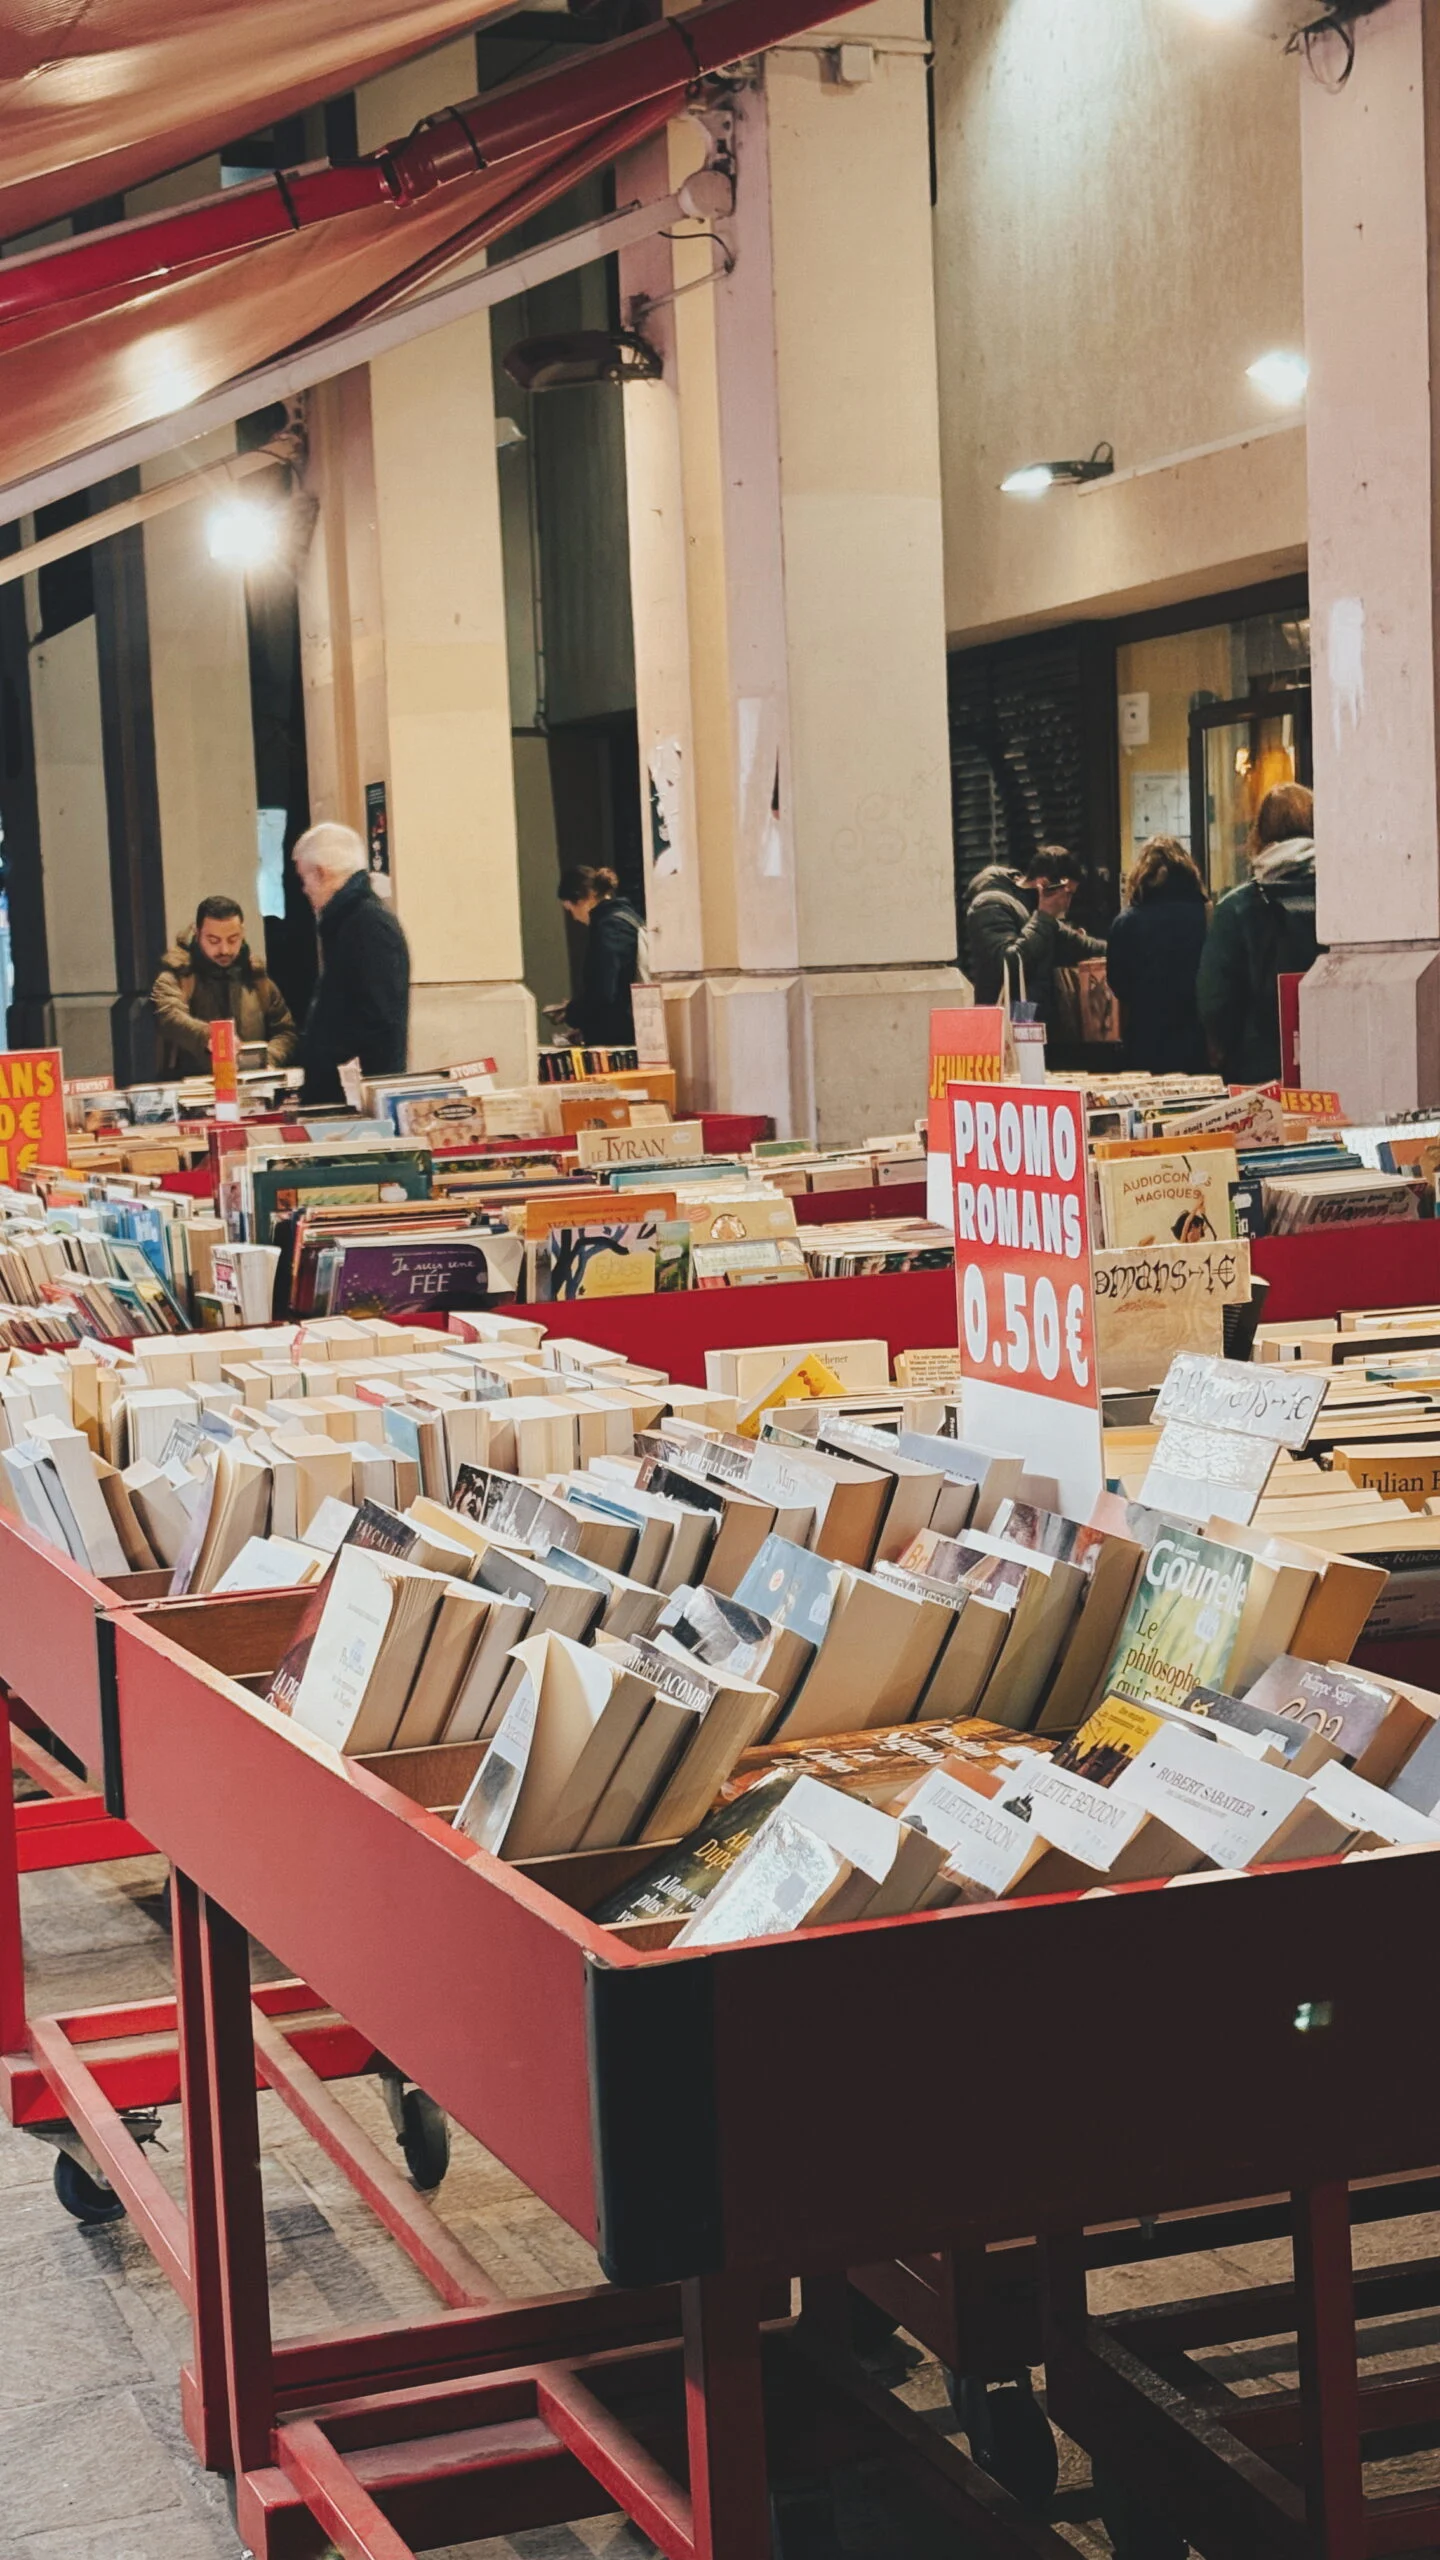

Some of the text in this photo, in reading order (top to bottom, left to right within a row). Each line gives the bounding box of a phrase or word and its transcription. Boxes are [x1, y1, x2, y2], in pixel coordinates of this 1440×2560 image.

[601, 1136, 666, 1162] TYRAN
[953, 1099, 1077, 1182] PROMO
[1123, 1172, 1212, 1195] AUDIOCONS
[1134, 1187, 1203, 1206] MAGIQUES
[957, 1181, 1083, 1260] ROMANS
[409, 1269, 452, 1294] FÉE
[963, 1263, 1089, 1388] 0.50€
[1360, 1470, 1424, 1493] Julian
[1146, 1539, 1247, 1618] Gounelle
[1136, 1608, 1158, 1640] Le
[1120, 1643, 1201, 1696] philosophe
[1023, 1771, 1077, 1801] JULIETTE
[1069, 1791, 1127, 1829] BENZONI
[1156, 1766, 1205, 1796] ROBERT
[1200, 1786, 1257, 1818] SABATIER
[968, 1810, 1020, 1853] BENZONI
[630, 1893, 665, 1915] plus
[652, 1874, 693, 1903] Allons
